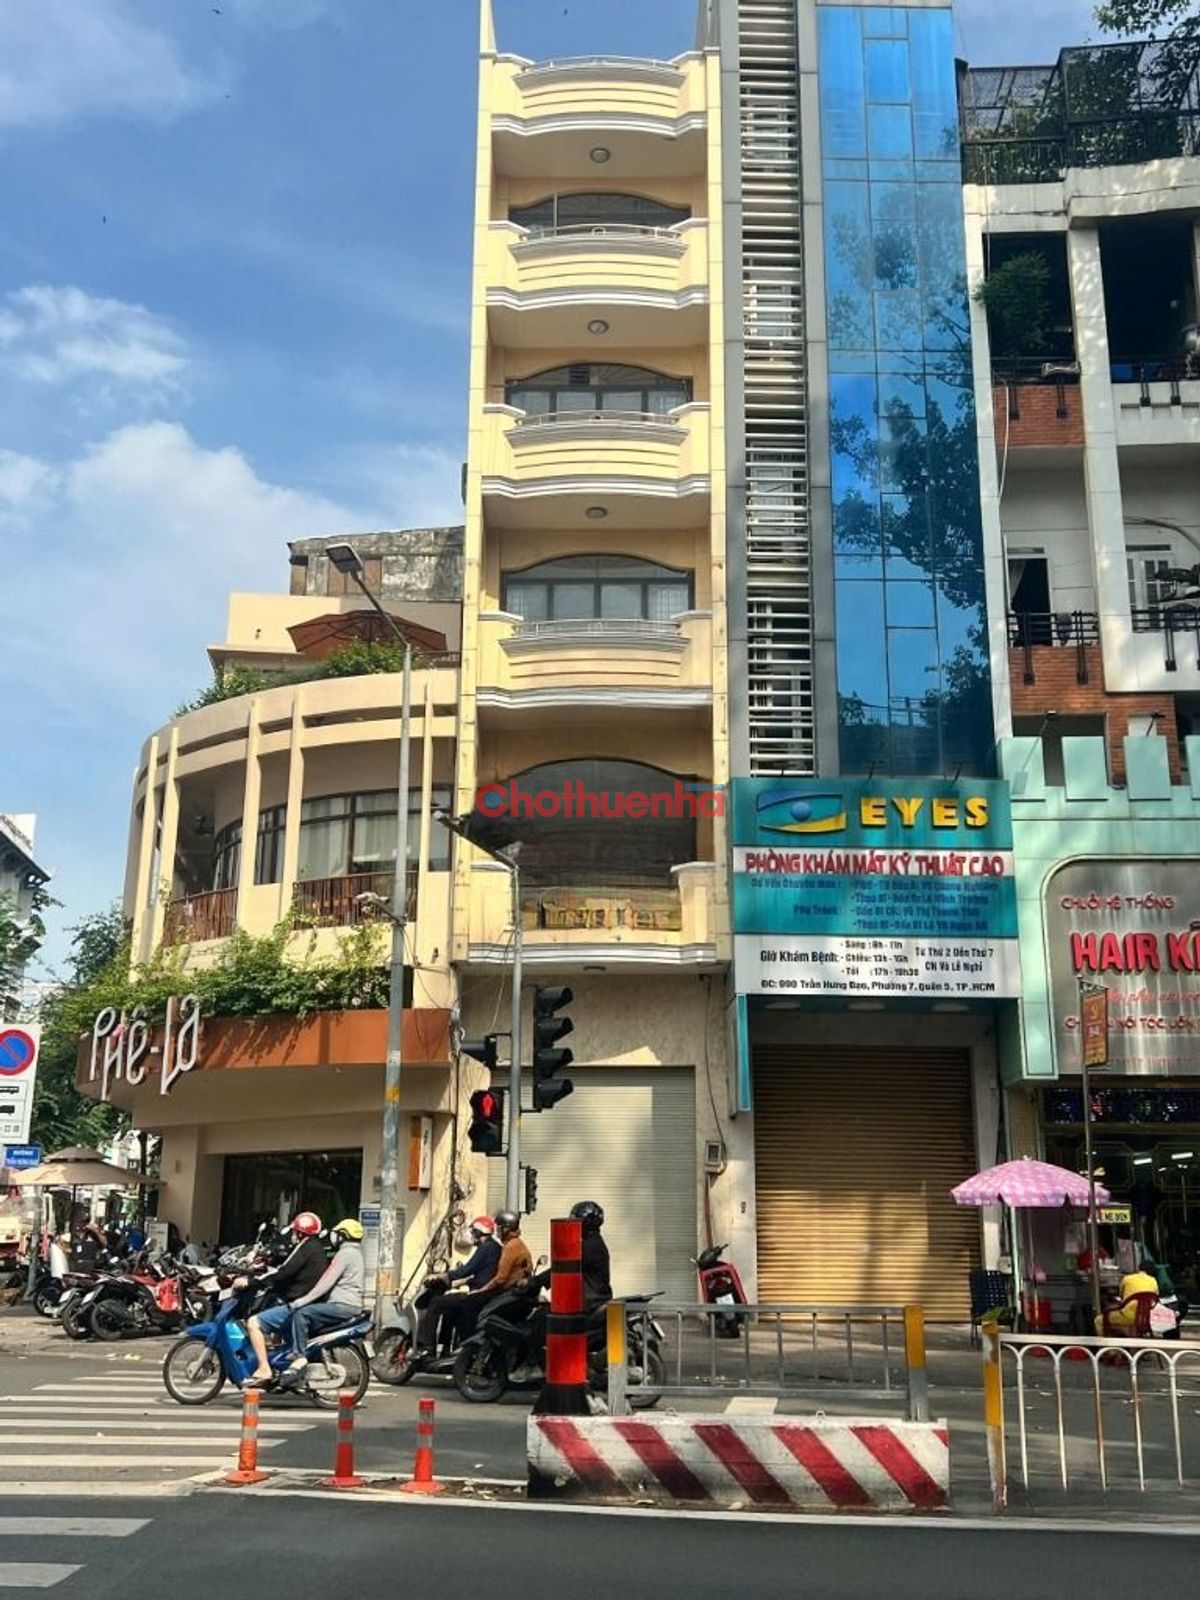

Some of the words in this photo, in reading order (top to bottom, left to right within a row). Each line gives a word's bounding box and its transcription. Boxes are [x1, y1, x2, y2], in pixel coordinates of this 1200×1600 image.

[861, 797, 989, 828] EYES
[745, 849, 801, 874] PHÒNG
[803, 849, 850, 875] KHÁM
[969, 855, 1004, 876] CAO
[760, 950, 777, 962] Giờ
[780, 950, 809, 962] Khám
[1071, 932, 1161, 972] HAIR
[800, 978, 821, 989] Trần
